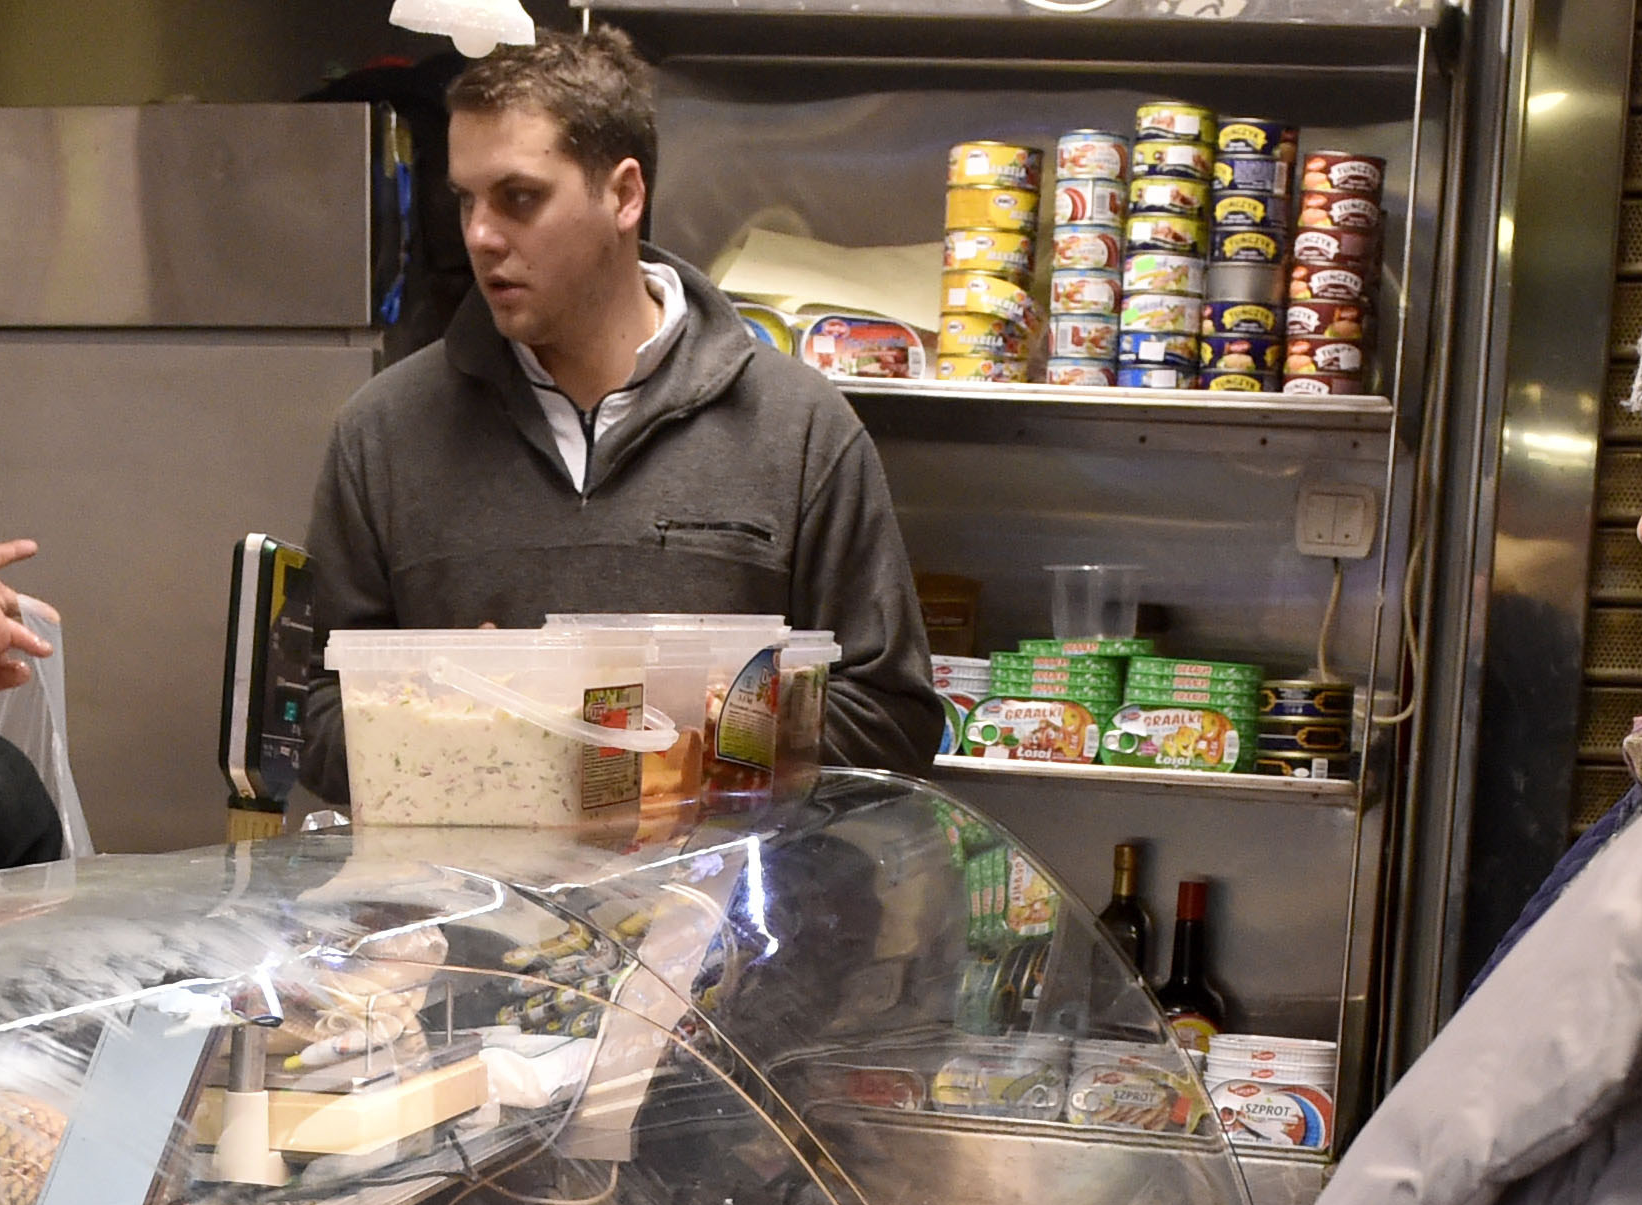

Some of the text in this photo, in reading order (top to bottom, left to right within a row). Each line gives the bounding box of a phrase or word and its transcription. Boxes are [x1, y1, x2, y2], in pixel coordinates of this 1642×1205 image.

[1005, 707, 1063, 720] GRAALKI
[1143, 712, 1203, 727] GRAALKI
[1113, 1089, 1158, 1103] SZPROT
[1244, 1103, 1292, 1117] SZPROT
